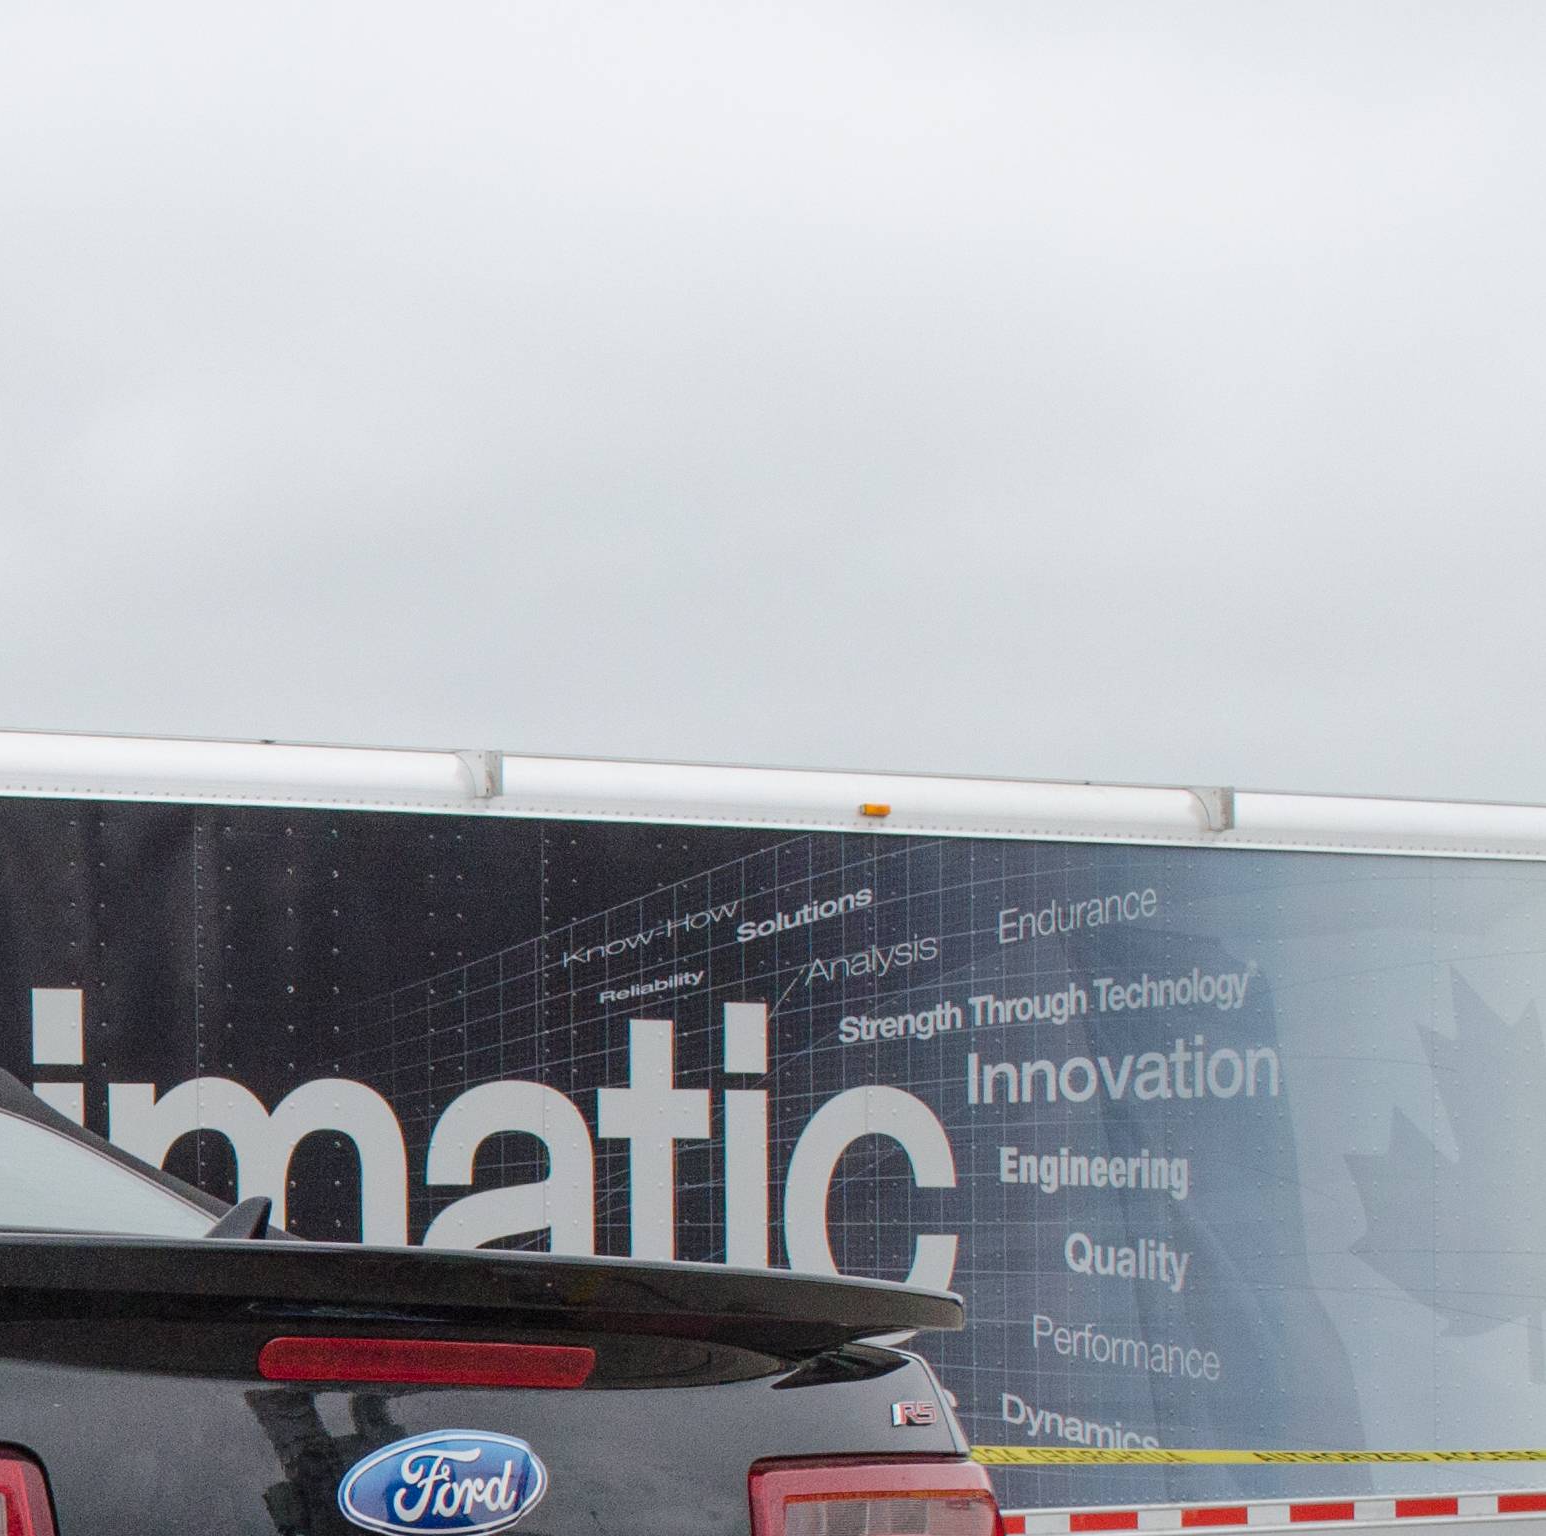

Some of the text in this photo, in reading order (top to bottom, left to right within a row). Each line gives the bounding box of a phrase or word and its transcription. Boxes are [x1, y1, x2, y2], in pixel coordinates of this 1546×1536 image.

[563, 900, 740, 967] Know-How
[736, 887, 873, 943] Solutions
[998, 888, 1157, 944] Endurance
[599, 971, 705, 1004] Reliability
[804, 934, 939, 986] Analysis
[838, 1001, 962, 1044] Strength
[968, 982, 1087, 1025] Through
[967, 1034, 1279, 1104] Innovation
[1000, 1146, 1189, 1200] Engineering
[1064, 1232, 1190, 1293] Quality
[1033, 1314, 1221, 1380] Performance
[892, 1401, 937, 1427] RS
[1253, 1451, 1430, 1463] AUTHORIZED
[393, 1448, 518, 1523] Ford
